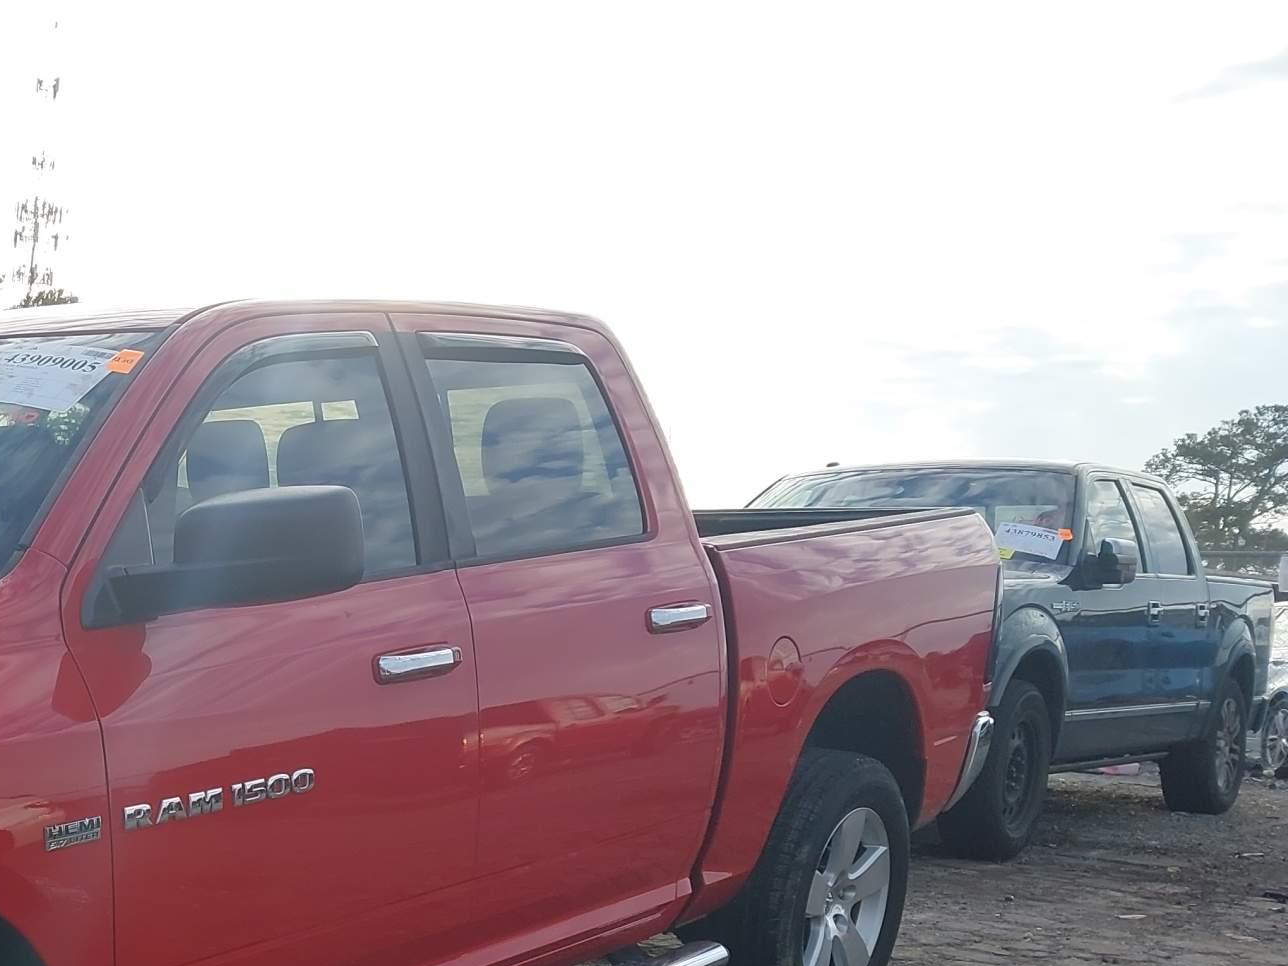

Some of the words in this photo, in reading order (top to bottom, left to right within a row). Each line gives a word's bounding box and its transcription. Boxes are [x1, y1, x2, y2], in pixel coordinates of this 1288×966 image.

[5, 353, 101, 373] 43909005
[123, 786, 224, 831] RAM
[231, 768, 315, 806] 1500
[47, 816, 102, 839] HEMI
